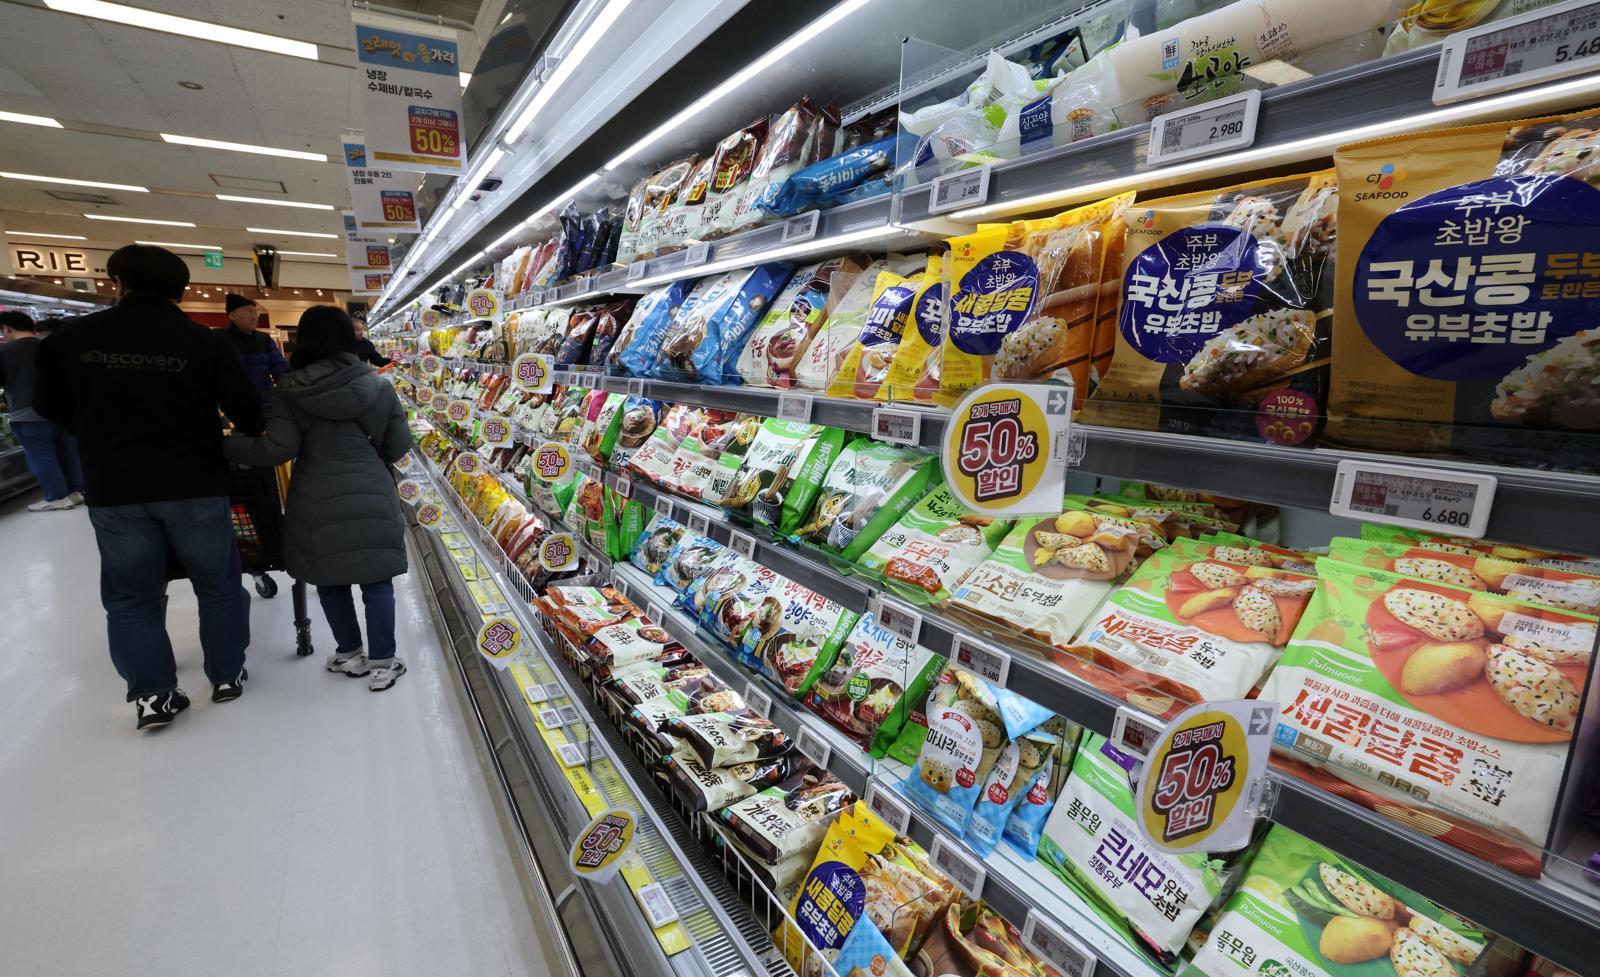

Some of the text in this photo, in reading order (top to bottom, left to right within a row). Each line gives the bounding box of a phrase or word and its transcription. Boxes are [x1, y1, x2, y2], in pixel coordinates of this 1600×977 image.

[366, 69, 387, 82] 냉장
[368, 82, 433, 100] 수제비/칼국수
[416, 128, 454, 152] 50%
[1209, 121, 1243, 140] 2.980
[818, 167, 854, 192] 동치미
[962, 185, 980, 197] 2.480
[1366, 174, 1382, 184] CJ
[1354, 190, 1408, 202] SEAFOOD
[1454, 190, 1514, 218] 주부
[1130, 228, 1162, 236] SEAFOOD
[1434, 214, 1531, 246] 초밥왕
[1187, 234, 1218, 252] 주부
[992, 260, 1012, 272] 주부
[1174, 252, 1222, 272] 초밥왕
[985, 274, 1016, 289] 초밥왕
[1128, 270, 1252, 312] 국산콩 두부
[1367, 252, 1536, 308] 국산콩
[954, 287, 1032, 316] 새콤달콤
[956, 312, 1014, 336] 유부초밥
[1144, 311, 1222, 336] 유부초밥
[1404, 310, 1553, 345] 유부초밥
[88, 350, 188, 372] Discovery
[519, 362, 544, 378] 50%
[972, 400, 1020, 419] 2개 구매시
[1276, 395, 1304, 406] 100%
[961, 419, 1035, 472] 50%
[538, 452, 565, 468] 50%
[978, 464, 1018, 497] 할인
[1422, 506, 1470, 527] 6.680
[784, 600, 812, 625] 평양
[1096, 614, 1200, 655] 새콤달콤
[1189, 650, 1216, 670] 초밥
[1308, 658, 1362, 683] Pulmuone
[982, 666, 1000, 682] 5.680
[1174, 722, 1226, 748] 2개 구매시
[1331, 688, 1350, 701] 사과
[1380, 707, 1401, 724] 더해
[1402, 716, 1454, 740] 새콤달콤한
[1454, 734, 1502, 760] 초밥소스
[926, 728, 957, 755] 마사각
[954, 750, 974, 766] 유부초밥
[1282, 688, 1464, 786] 새콤달콤
[1155, 744, 1230, 809] 50%
[1352, 758, 1372, 773] 330g
[1066, 796, 1102, 834] 풀무원
[1166, 795, 1212, 836] 할인
[1088, 854, 1124, 888] 정통유부
[1096, 828, 1166, 900] 큰네모
[842, 872, 856, 889] 주부
[1164, 880, 1188, 905] 유부
[806, 876, 855, 937] 새콤달콤
[1151, 893, 1182, 922] 초밥
[1240, 903, 1282, 935] Pulmuone
[800, 900, 838, 946] 유부초밥
[1218, 930, 1256, 968] 풀무원
